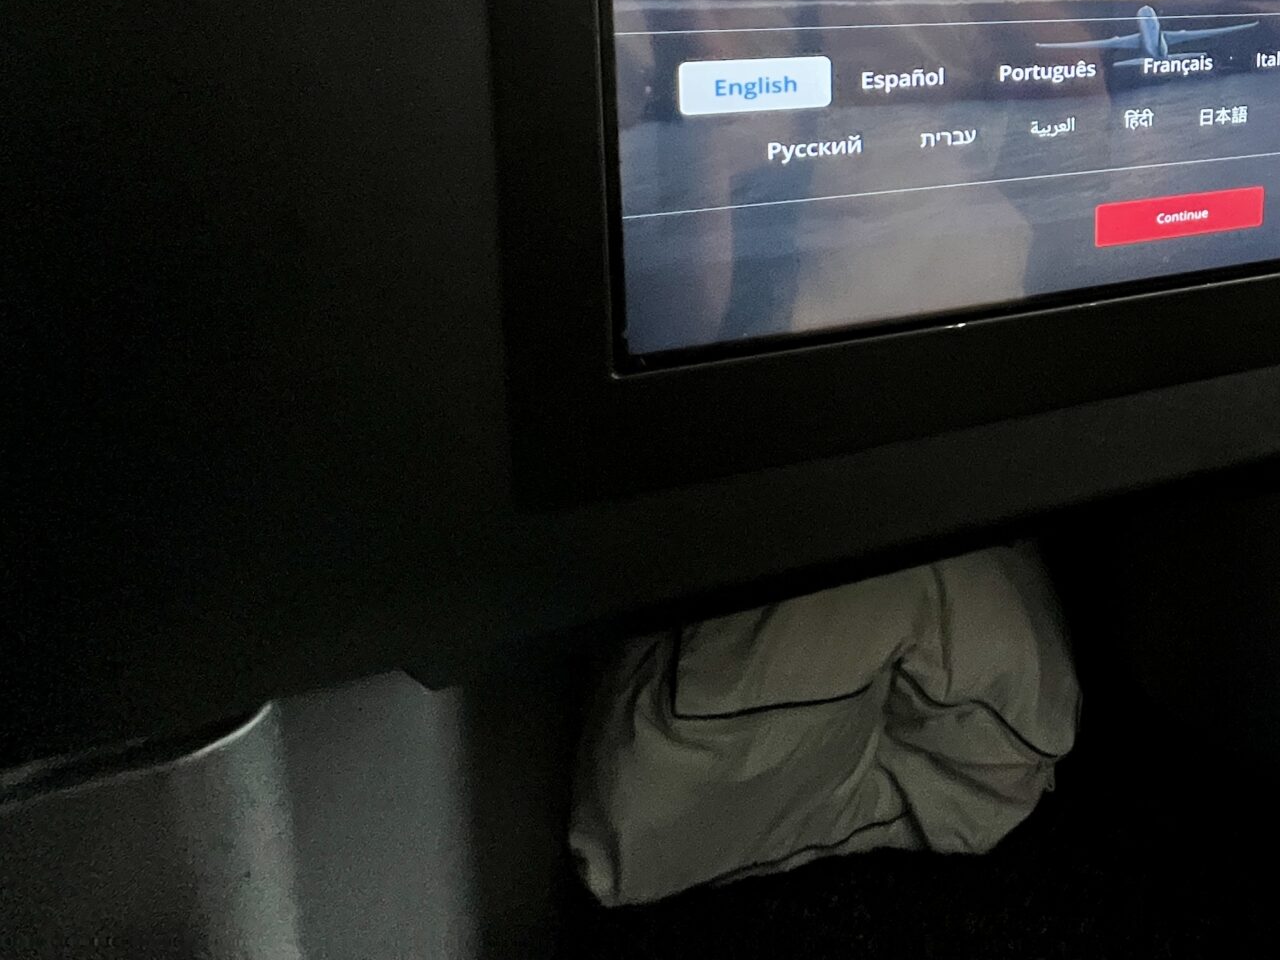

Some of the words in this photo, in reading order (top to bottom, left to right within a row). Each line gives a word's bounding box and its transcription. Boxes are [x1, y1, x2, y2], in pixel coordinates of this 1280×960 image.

[1000, 61, 1097, 83] Português
[1143, 56, 1214, 76] Français
[714, 75, 798, 100] English
[861, 67, 945, 93] Español
[1030, 117, 1076, 137] العربية
[1123, 109, 1155, 130] हिंदी
[1199, 106, 1248, 127] 日本語
[767, 134, 863, 165] Русский
[920, 129, 977, 150] עברית
[1156, 209, 1209, 225] Continue
